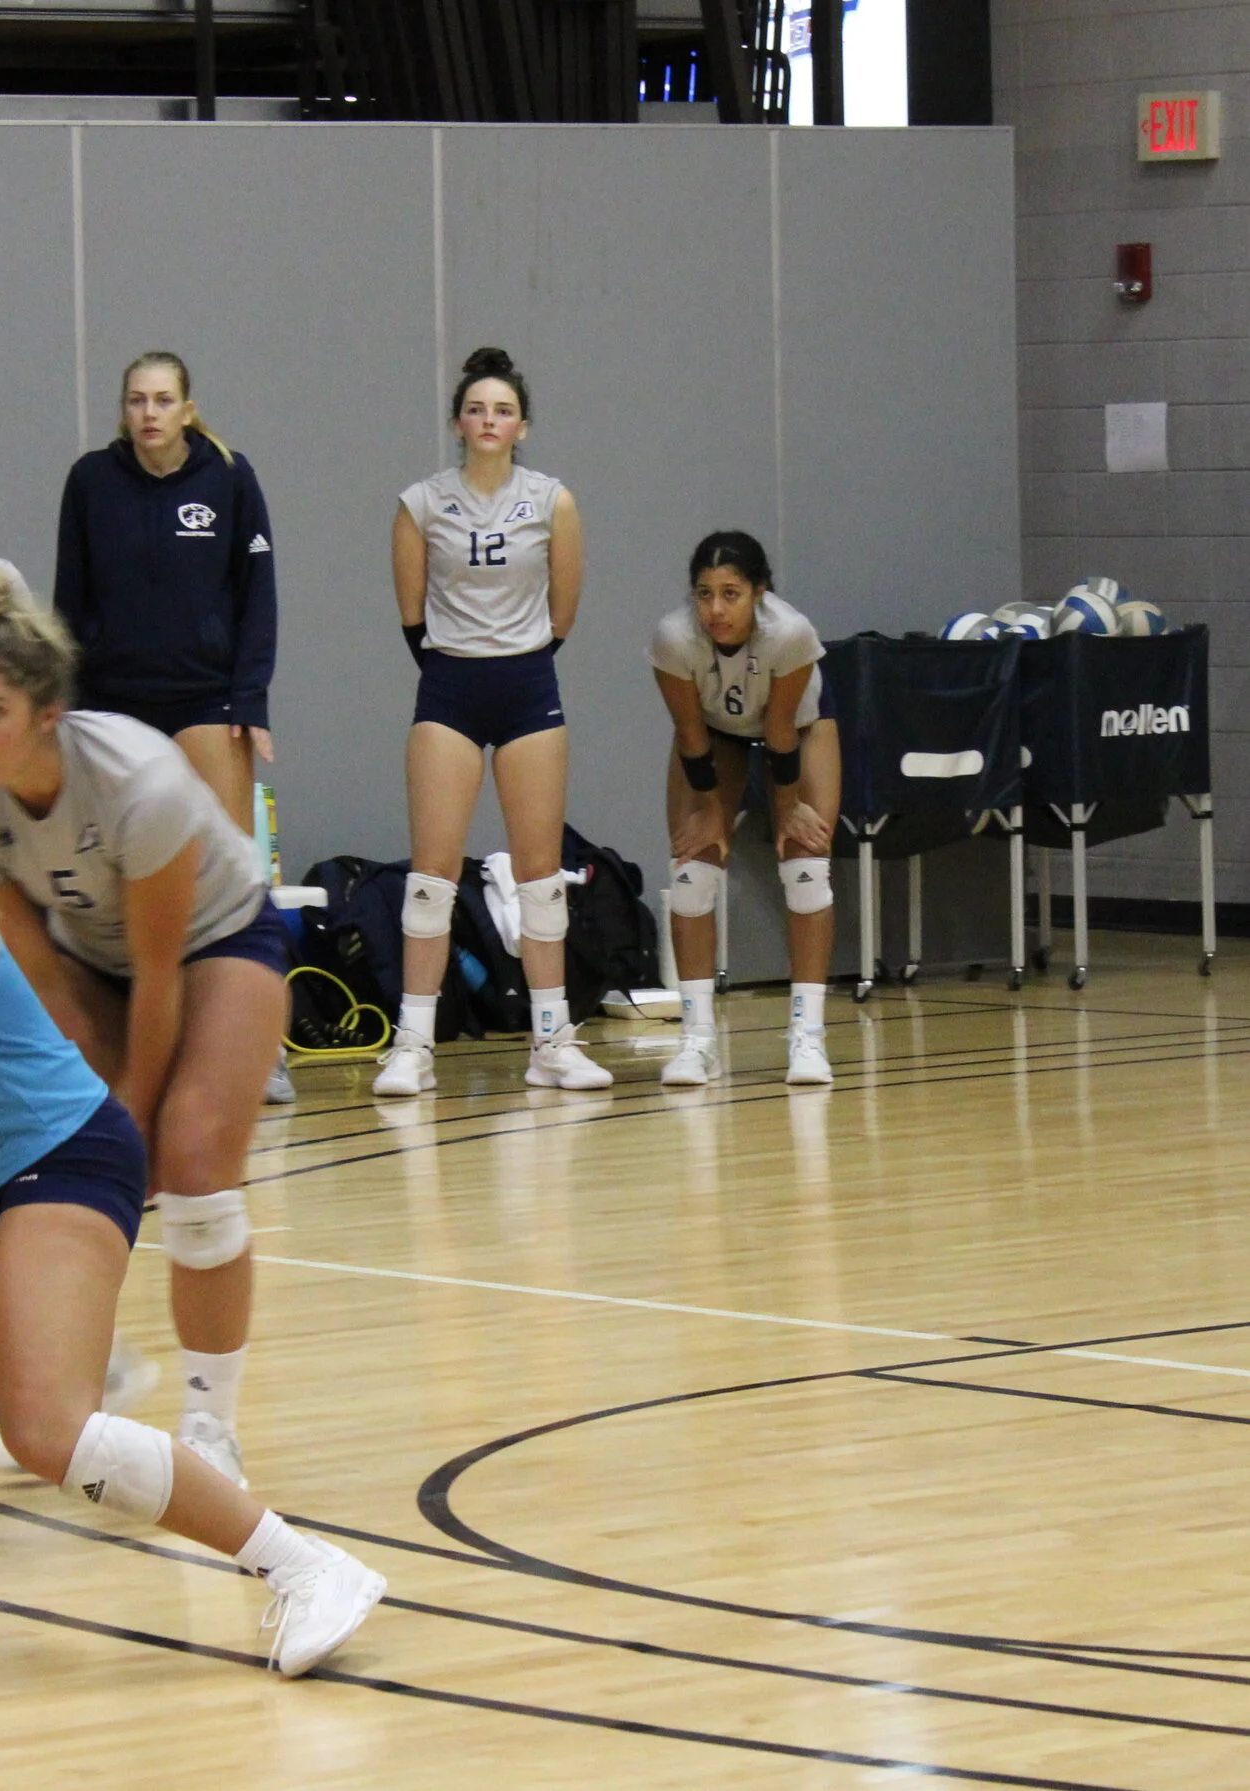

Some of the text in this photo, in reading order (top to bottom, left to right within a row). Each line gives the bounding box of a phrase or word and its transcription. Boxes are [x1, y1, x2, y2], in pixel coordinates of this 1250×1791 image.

[1150, 100, 1199, 152] EXIT
[468, 531, 507, 567] 12
[725, 684, 744, 716] 6
[49, 869, 95, 910] 5
